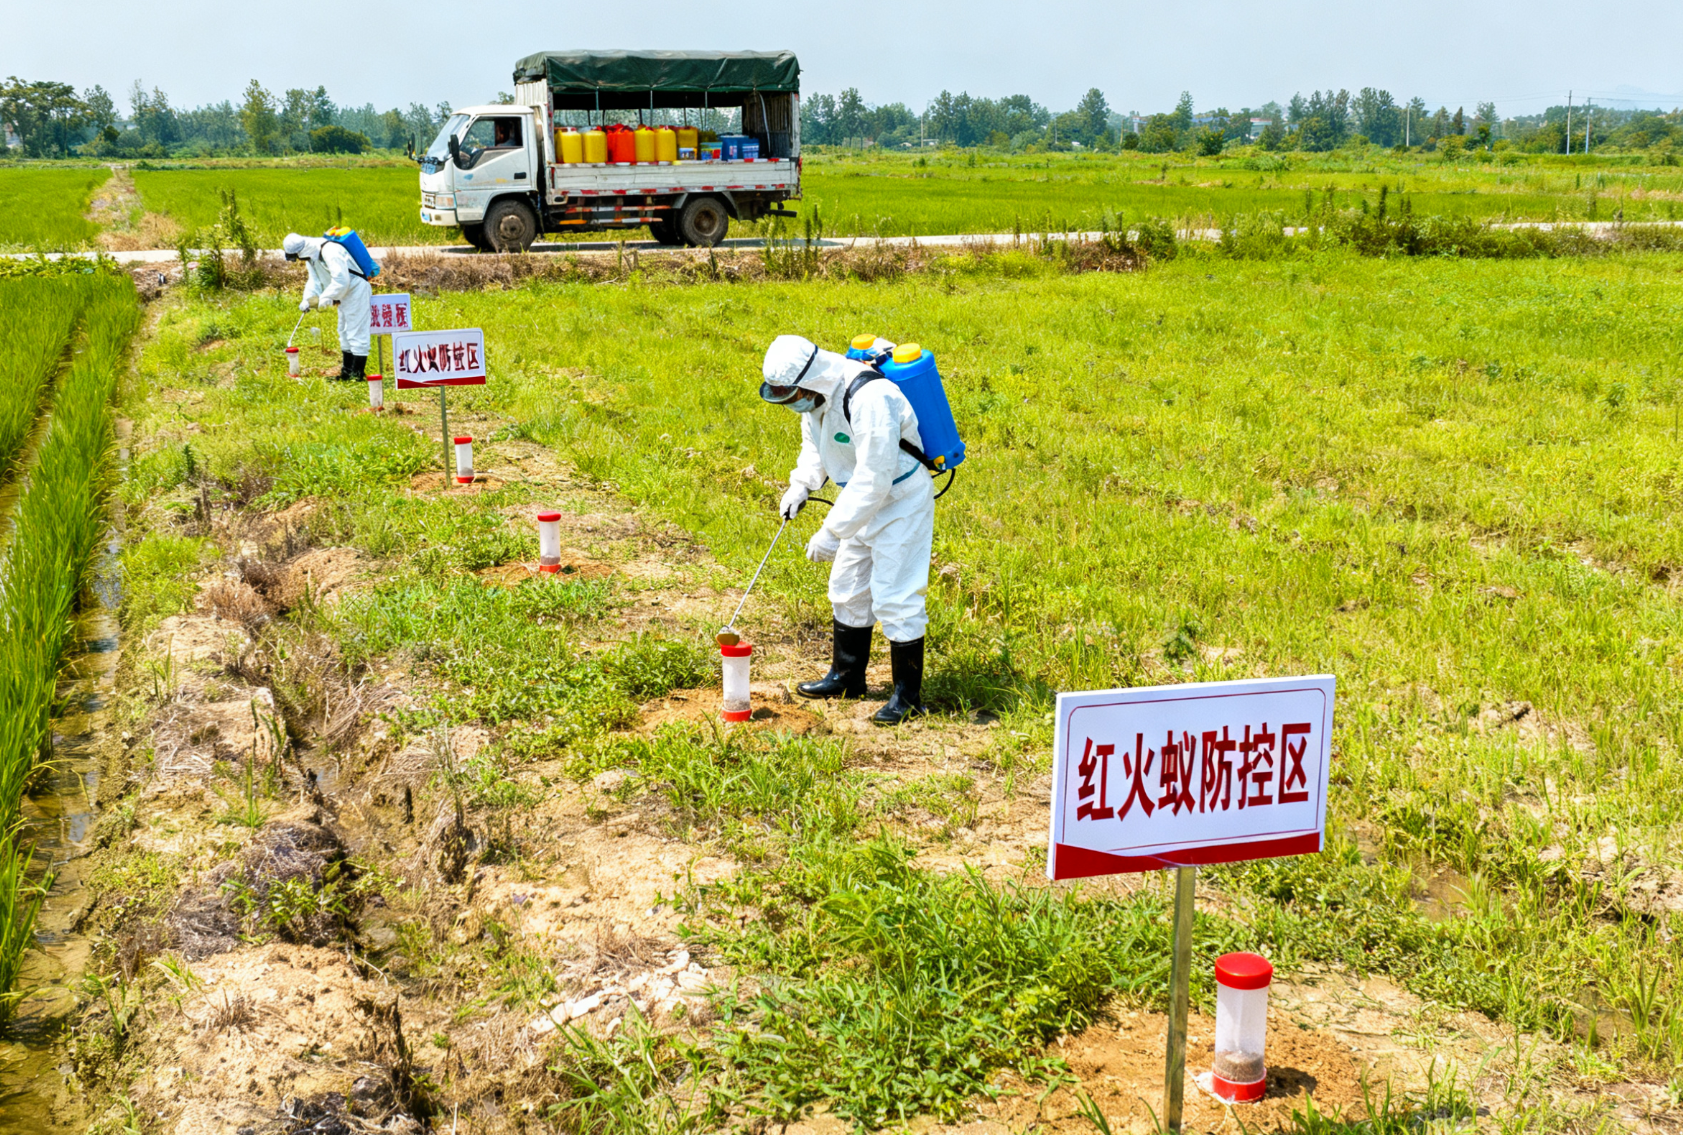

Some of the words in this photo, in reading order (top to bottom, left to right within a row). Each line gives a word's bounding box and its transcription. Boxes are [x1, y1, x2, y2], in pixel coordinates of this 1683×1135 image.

[1077, 722, 1311, 821] 红火蚁防控区
